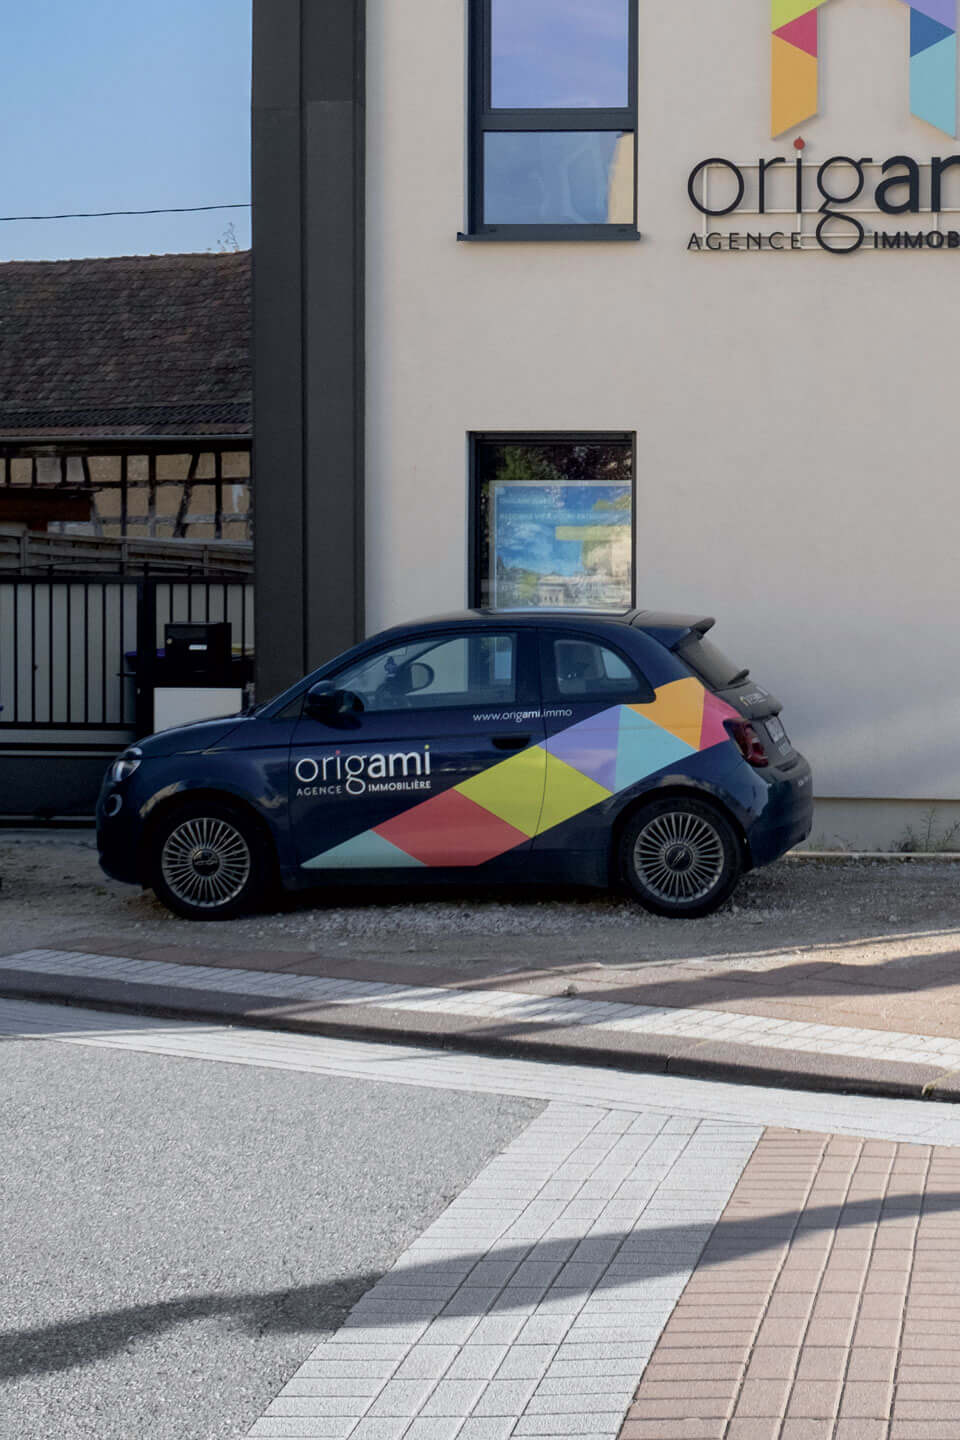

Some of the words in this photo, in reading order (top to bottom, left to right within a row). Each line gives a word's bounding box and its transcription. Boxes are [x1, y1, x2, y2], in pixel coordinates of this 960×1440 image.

[687, 231, 802, 250] AGENCE
[472, 708, 573, 723] www.origami.immo
[295, 744, 432, 795] origami
[296, 784, 343, 796] AGENCE
[368, 779, 432, 793] IMMOBILIÈRE
